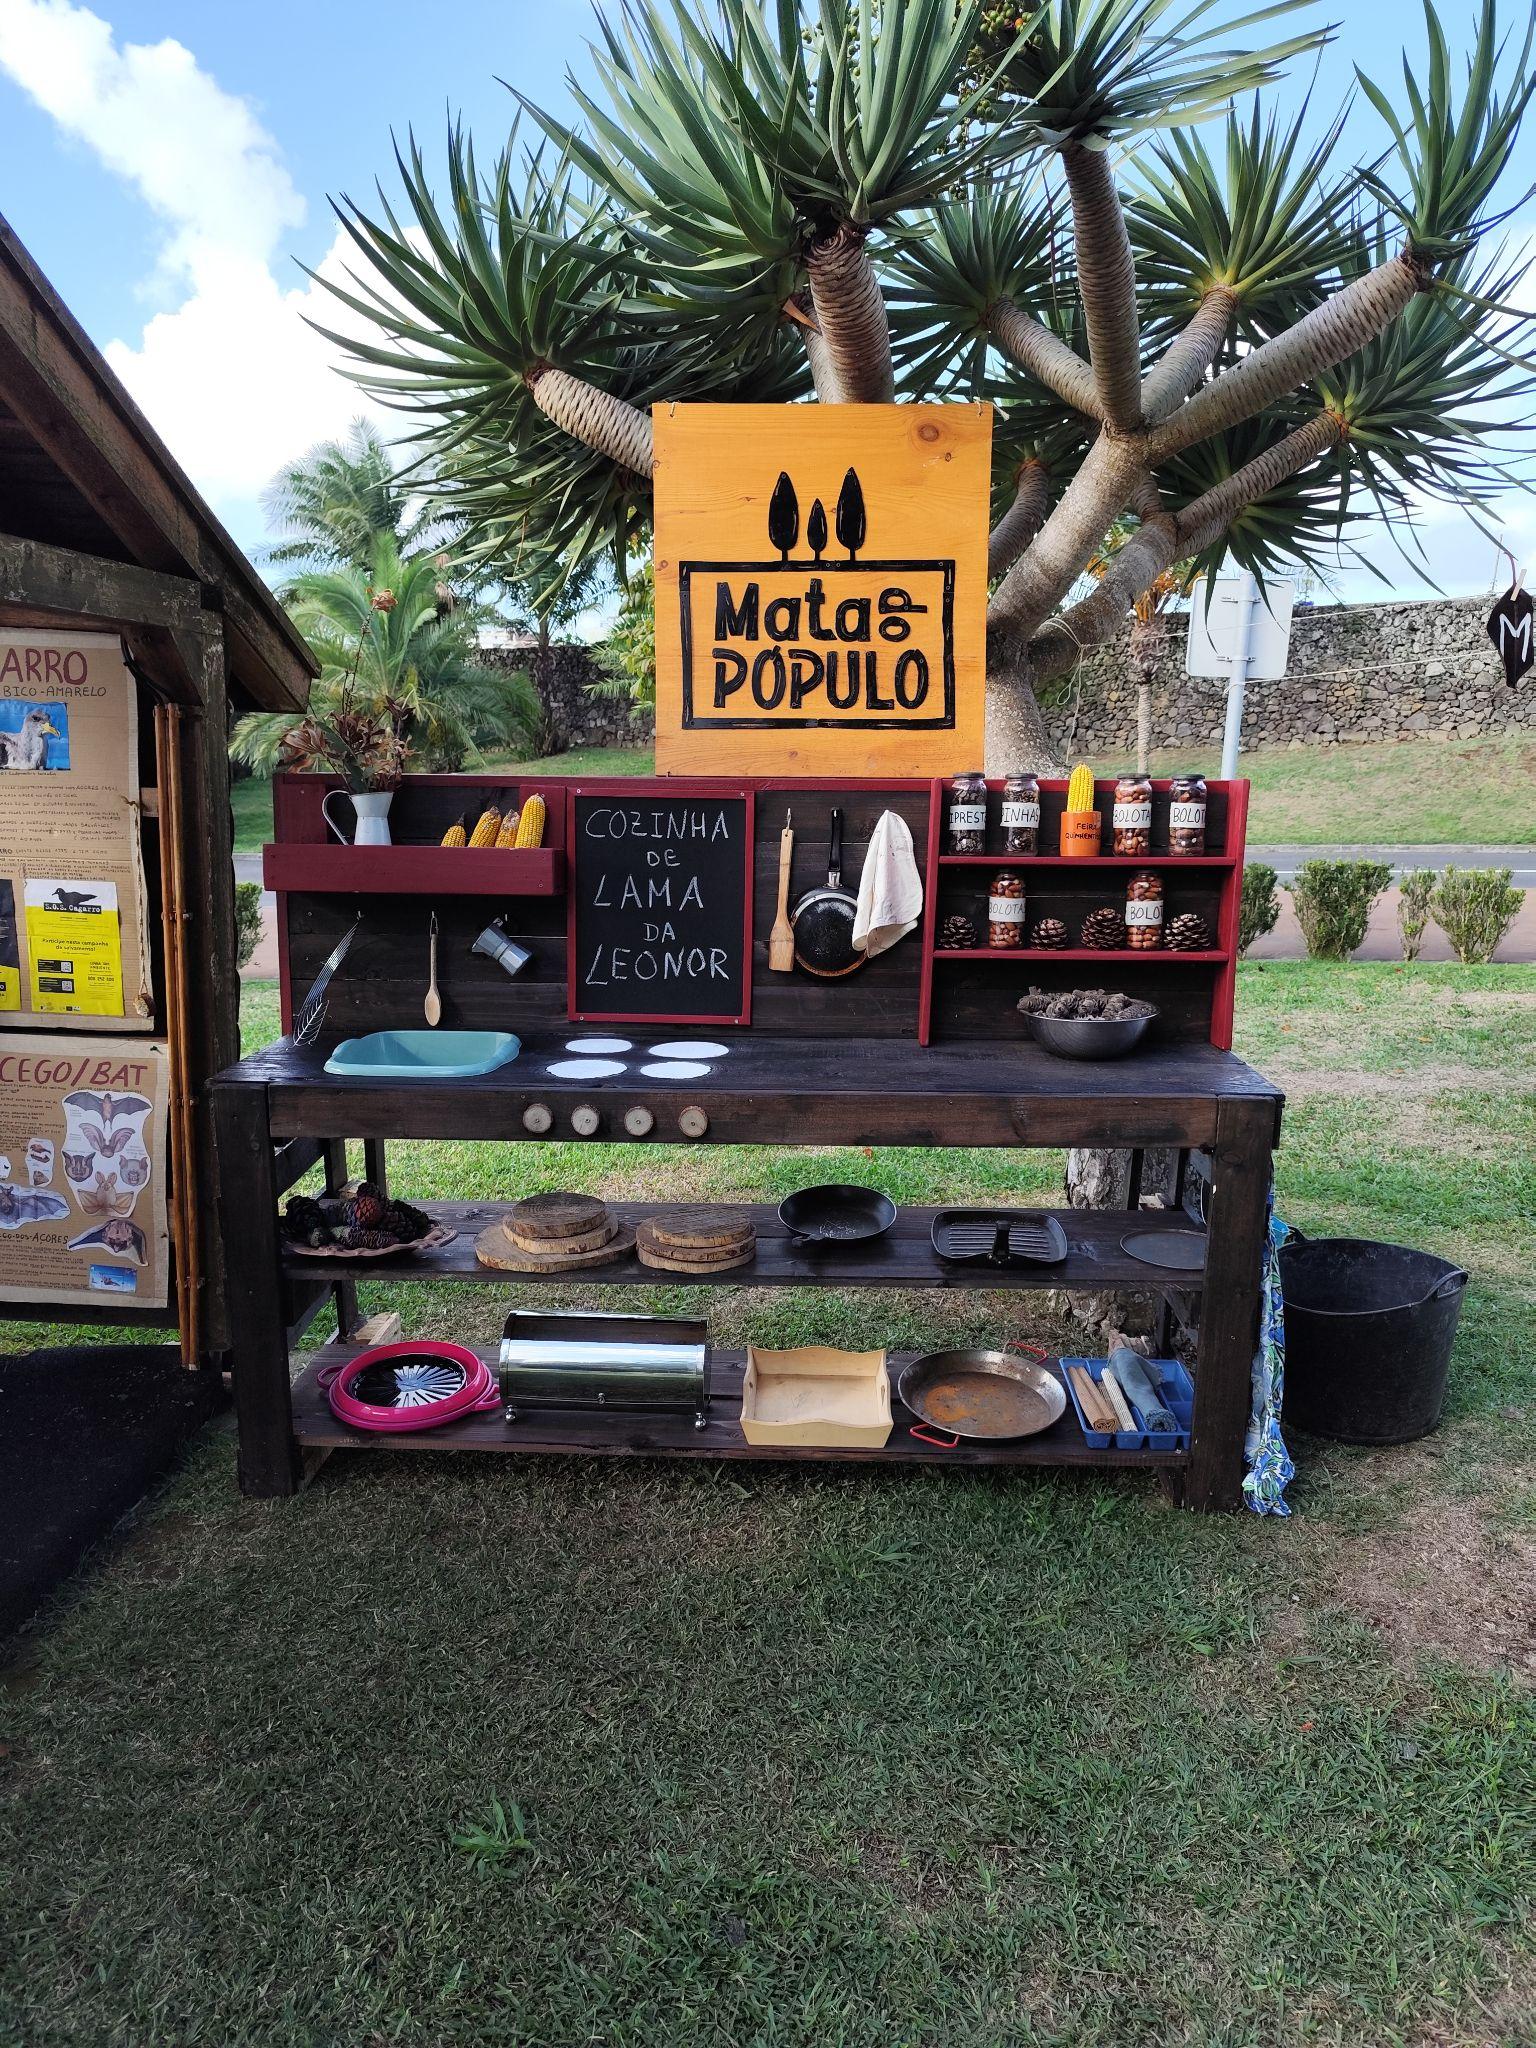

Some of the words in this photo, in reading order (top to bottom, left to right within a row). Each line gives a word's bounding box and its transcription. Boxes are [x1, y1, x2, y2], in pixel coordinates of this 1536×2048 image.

[715, 578, 871, 642] Mata
[1499, 612, 1532, 662] M
[0, 648, 88, 685] ARRO
[712, 645, 929, 710] PÓPULO
[585, 809, 729, 842] COZINHA
[646, 849, 680, 866] DE
[68, 905, 101, 913] Cagarro
[593, 874, 704, 911] LAMA
[643, 922, 676, 943] DA
[586, 944, 729, 985] LEONOR
